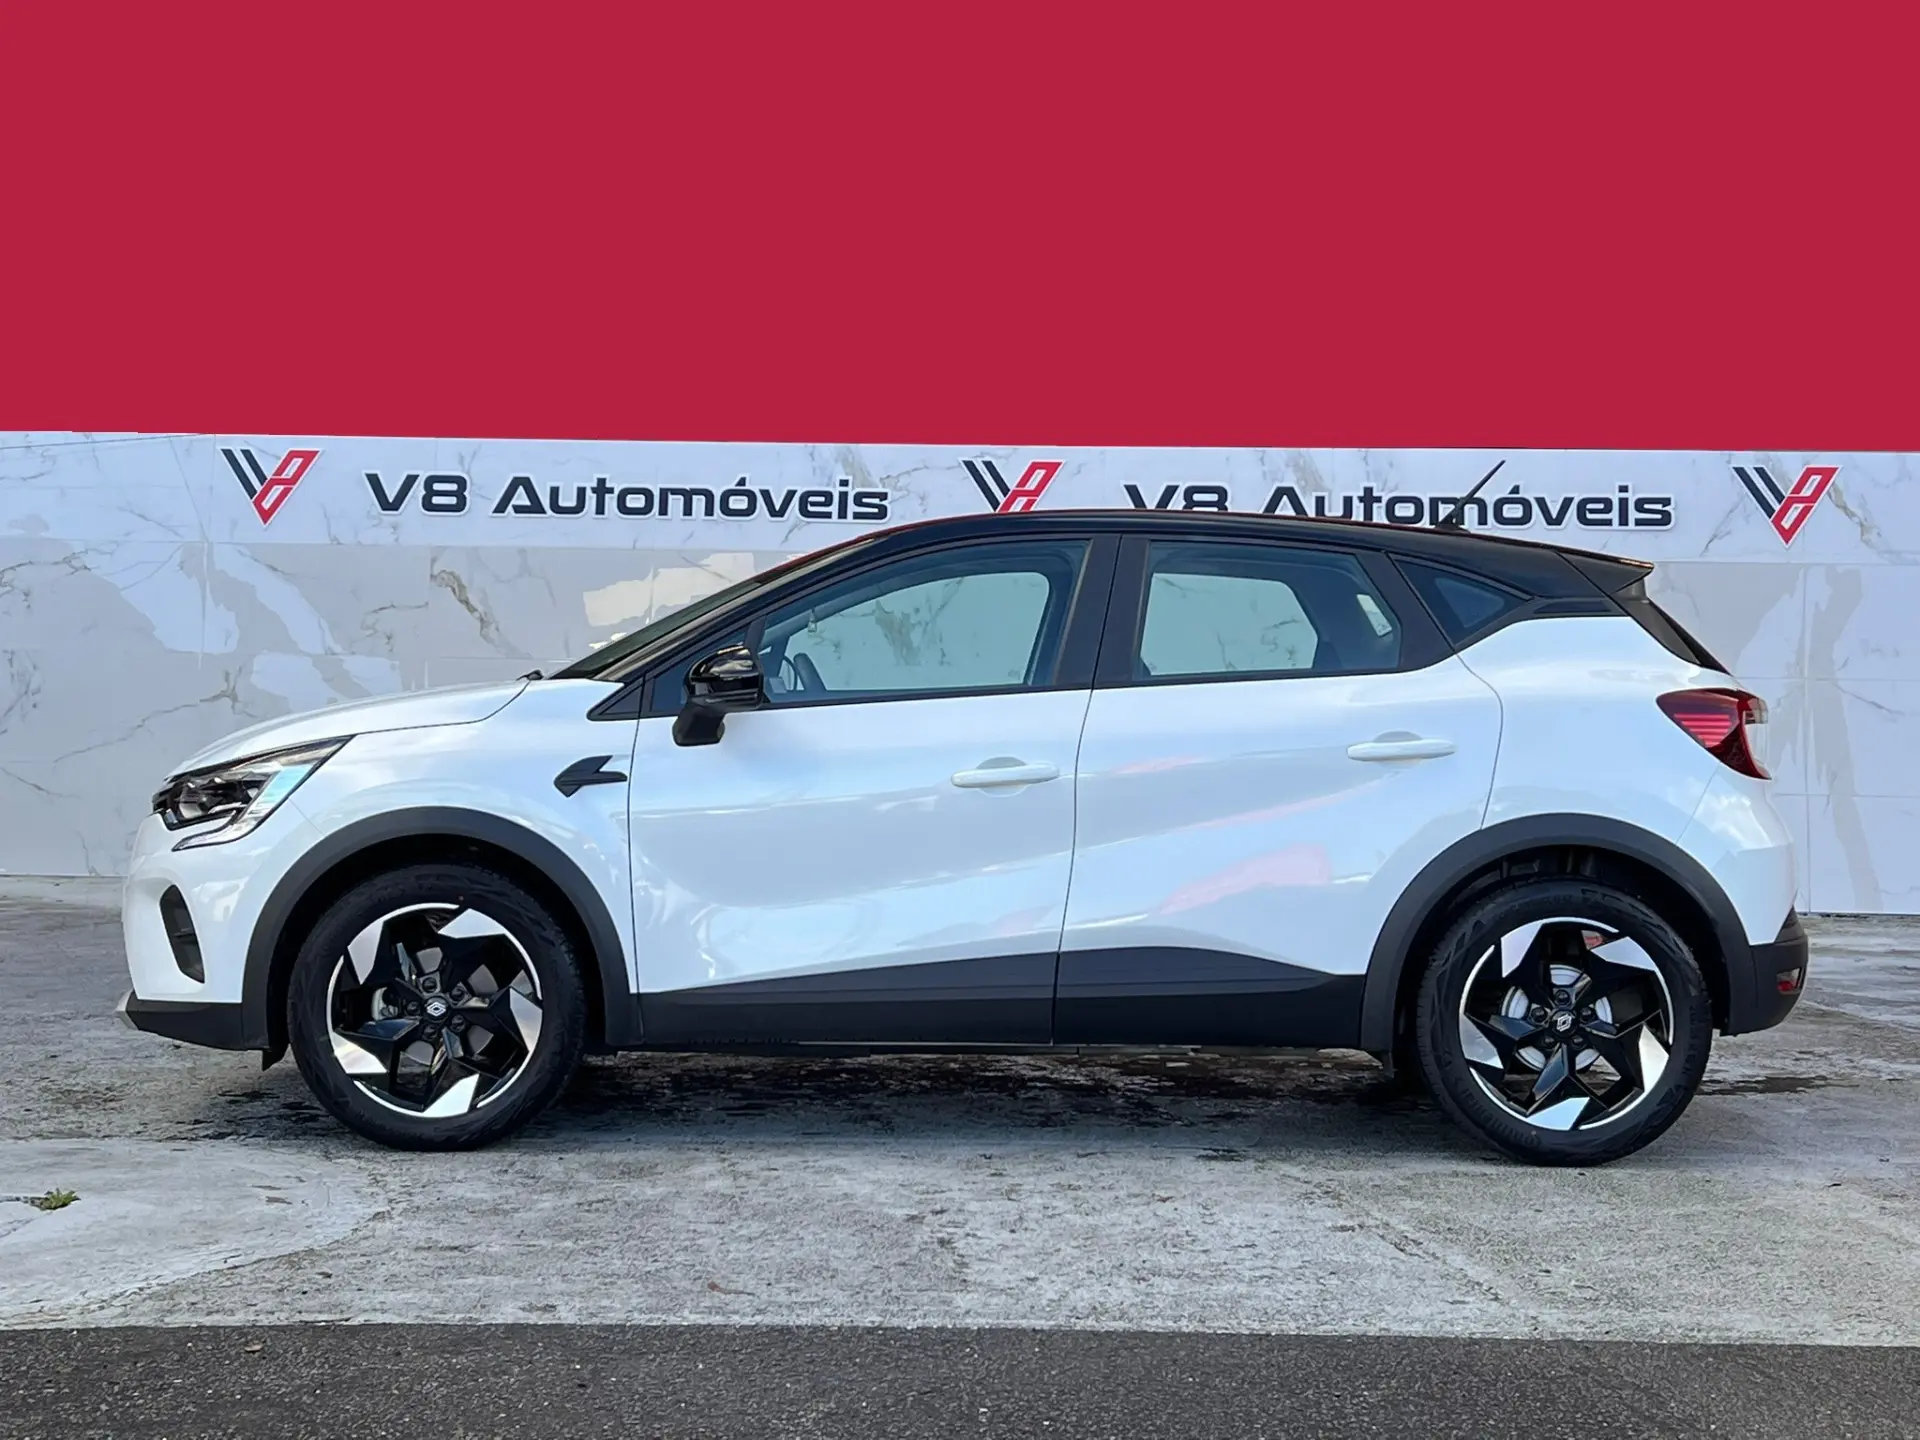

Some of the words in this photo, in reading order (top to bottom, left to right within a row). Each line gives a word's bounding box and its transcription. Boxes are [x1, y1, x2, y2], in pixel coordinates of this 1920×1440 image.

[366, 474, 467, 513] V8
[492, 476, 889, 521] Automóveis
[1123, 484, 1229, 512] V8
[1261, 484, 1672, 528] Automóveis
